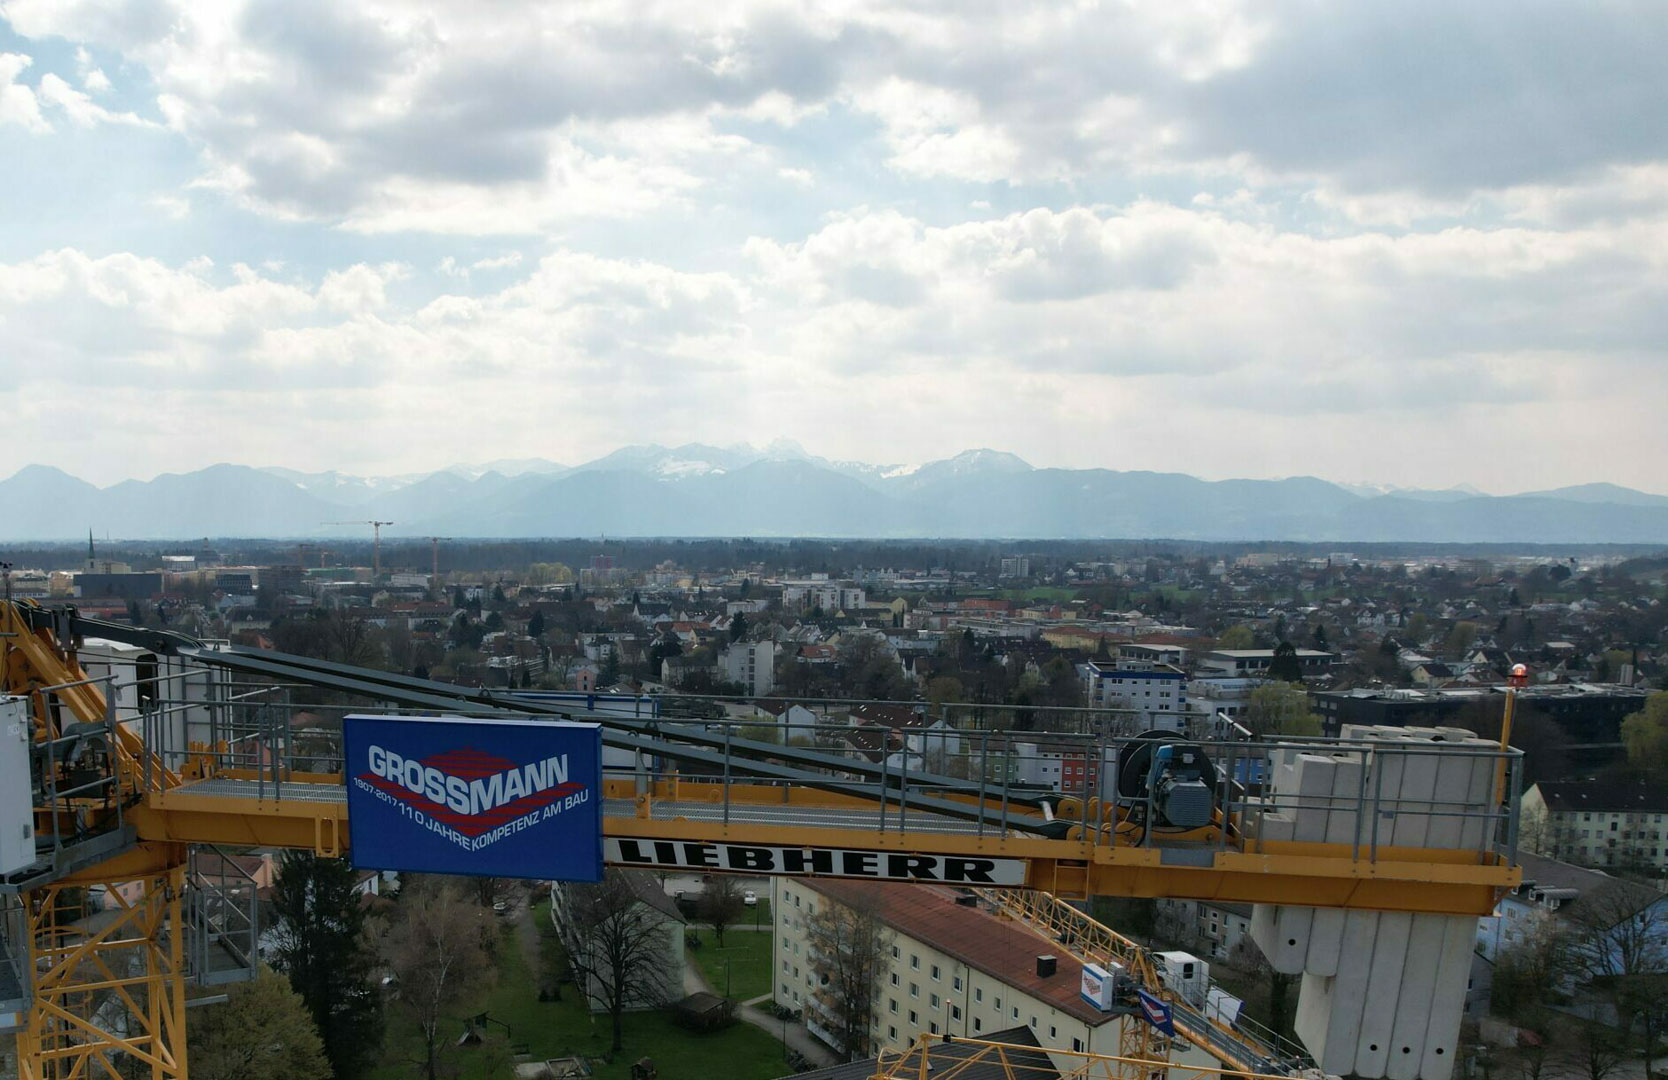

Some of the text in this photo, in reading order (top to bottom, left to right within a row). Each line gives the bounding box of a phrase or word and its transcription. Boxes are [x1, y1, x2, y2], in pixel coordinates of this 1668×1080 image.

[353, 777, 399, 807] 1907-2017
[425, 820, 470, 851] JAHRE
[471, 814, 540, 851] KOMPETENZ
[543, 802, 562, 820] AM
[565, 789, 589, 810] BAU
[368, 745, 568, 816] GROSSMANN
[618, 840, 996, 883] LIEBHERR
